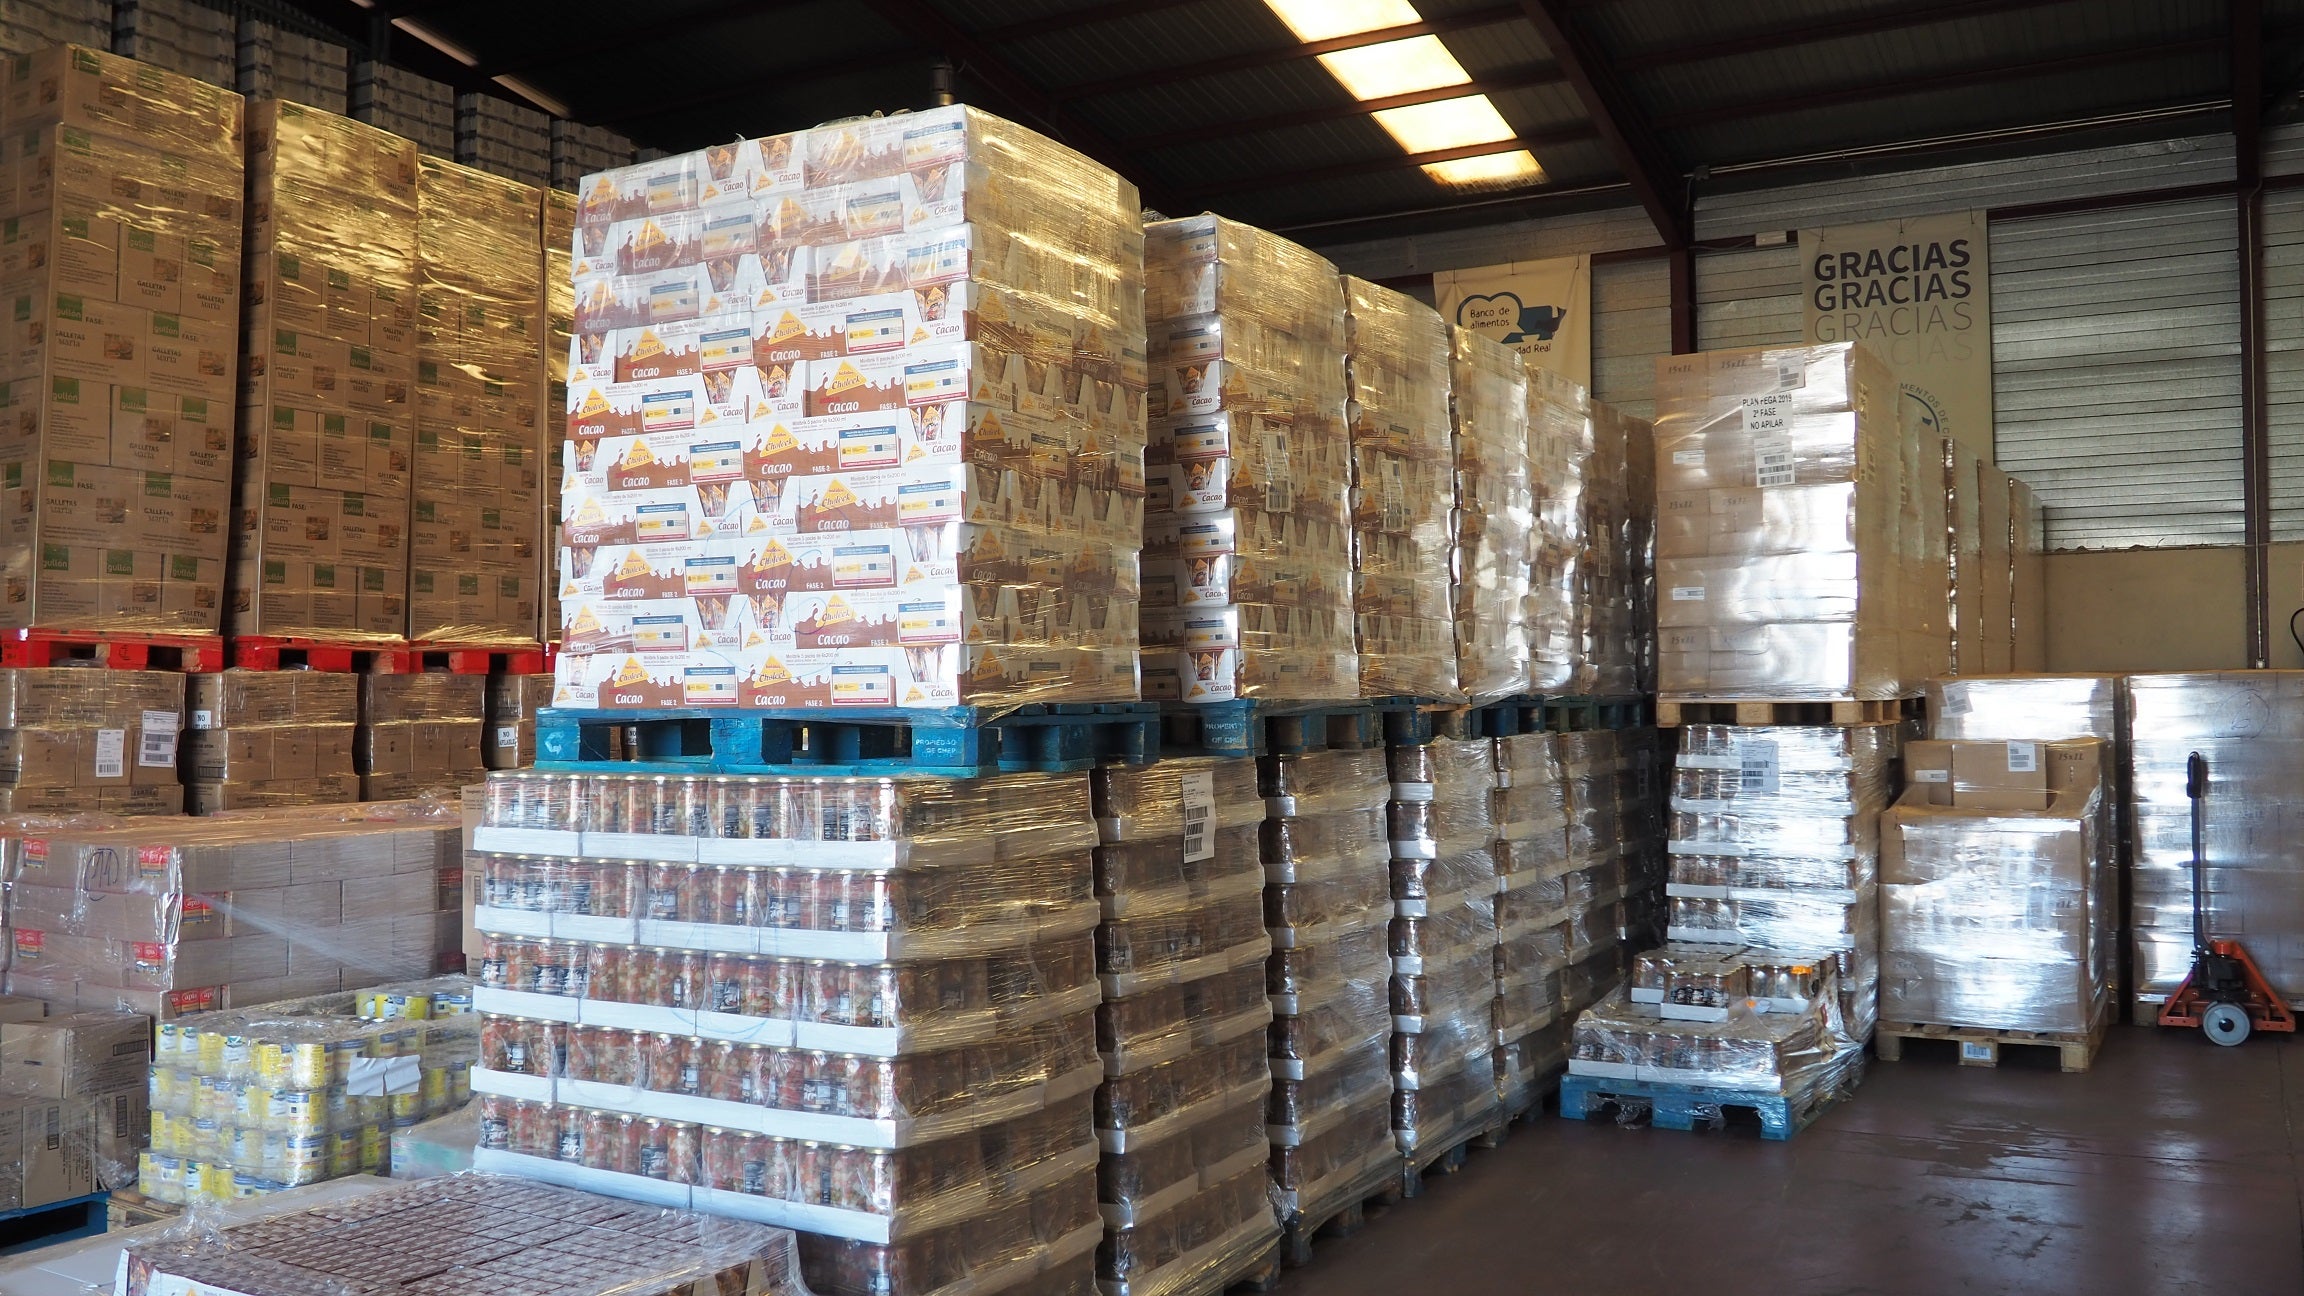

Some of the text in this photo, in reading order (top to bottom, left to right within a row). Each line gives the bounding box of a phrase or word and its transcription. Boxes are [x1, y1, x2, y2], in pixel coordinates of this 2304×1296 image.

[779, 173, 800, 182] Cacao
[724, 182, 743, 191] Cacao
[1814, 239, 1970, 282] GRACIAS
[138, 280, 166, 291] GALLETAS
[782, 289, 803, 297] Cacao
[1814, 270, 1972, 312] GRACIAS
[197, 294, 224, 304] GALLETAS
[1470, 307, 1510, 318] Banco de
[1470, 320, 1510, 329] alimentos
[1815, 302, 1972, 343] GRACIAS
[936, 326, 959, 335] Cacao
[153, 347, 181, 356] GALLETAS
[1516, 343, 1551, 354] dad Real
[1871, 332, 1974, 367] ACIAS
[771, 350, 800, 361] Cacao
[632, 367, 659, 378] Cacao
[1900, 383, 1941, 408] MENTOS
[1742, 397, 1759, 406] PLAN
[777, 402, 799, 411] Cacao
[828, 401, 859, 413] Cacao
[723, 408, 743, 417] Cacao
[1760, 408, 1776, 416] FASE
[1750, 419, 1783, 430] NO APILAR
[579, 425, 604, 435] Cacao
[130, 443, 159, 452] GALLETAS
[932, 444, 956, 453] Cacao
[190, 451, 218, 460] GALLETAS
[762, 464, 792, 474] Cacao
[585, 476, 603, 484] Cacao
[623, 477, 649, 487] Cacao
[1202, 493, 1222, 502] Cacao
[144, 507, 174, 516] GALLETAS
[719, 522, 738, 530] Cacao
[773, 518, 794, 526] Cacao
[818, 520, 848, 530] Cacao
[573, 533, 599, 543] Cacao
[756, 579, 786, 589] Cacao
[618, 588, 644, 597] Cacao
[718, 635, 738, 643] Cacao
[770, 633, 791, 641] Cacao
[818, 634, 849, 645] Cacao
[1210, 683, 1232, 692] Cacao
[616, 694, 643, 704] Cacao
[755, 695, 785, 705] Cacao
[198, 714, 206, 722] NO
